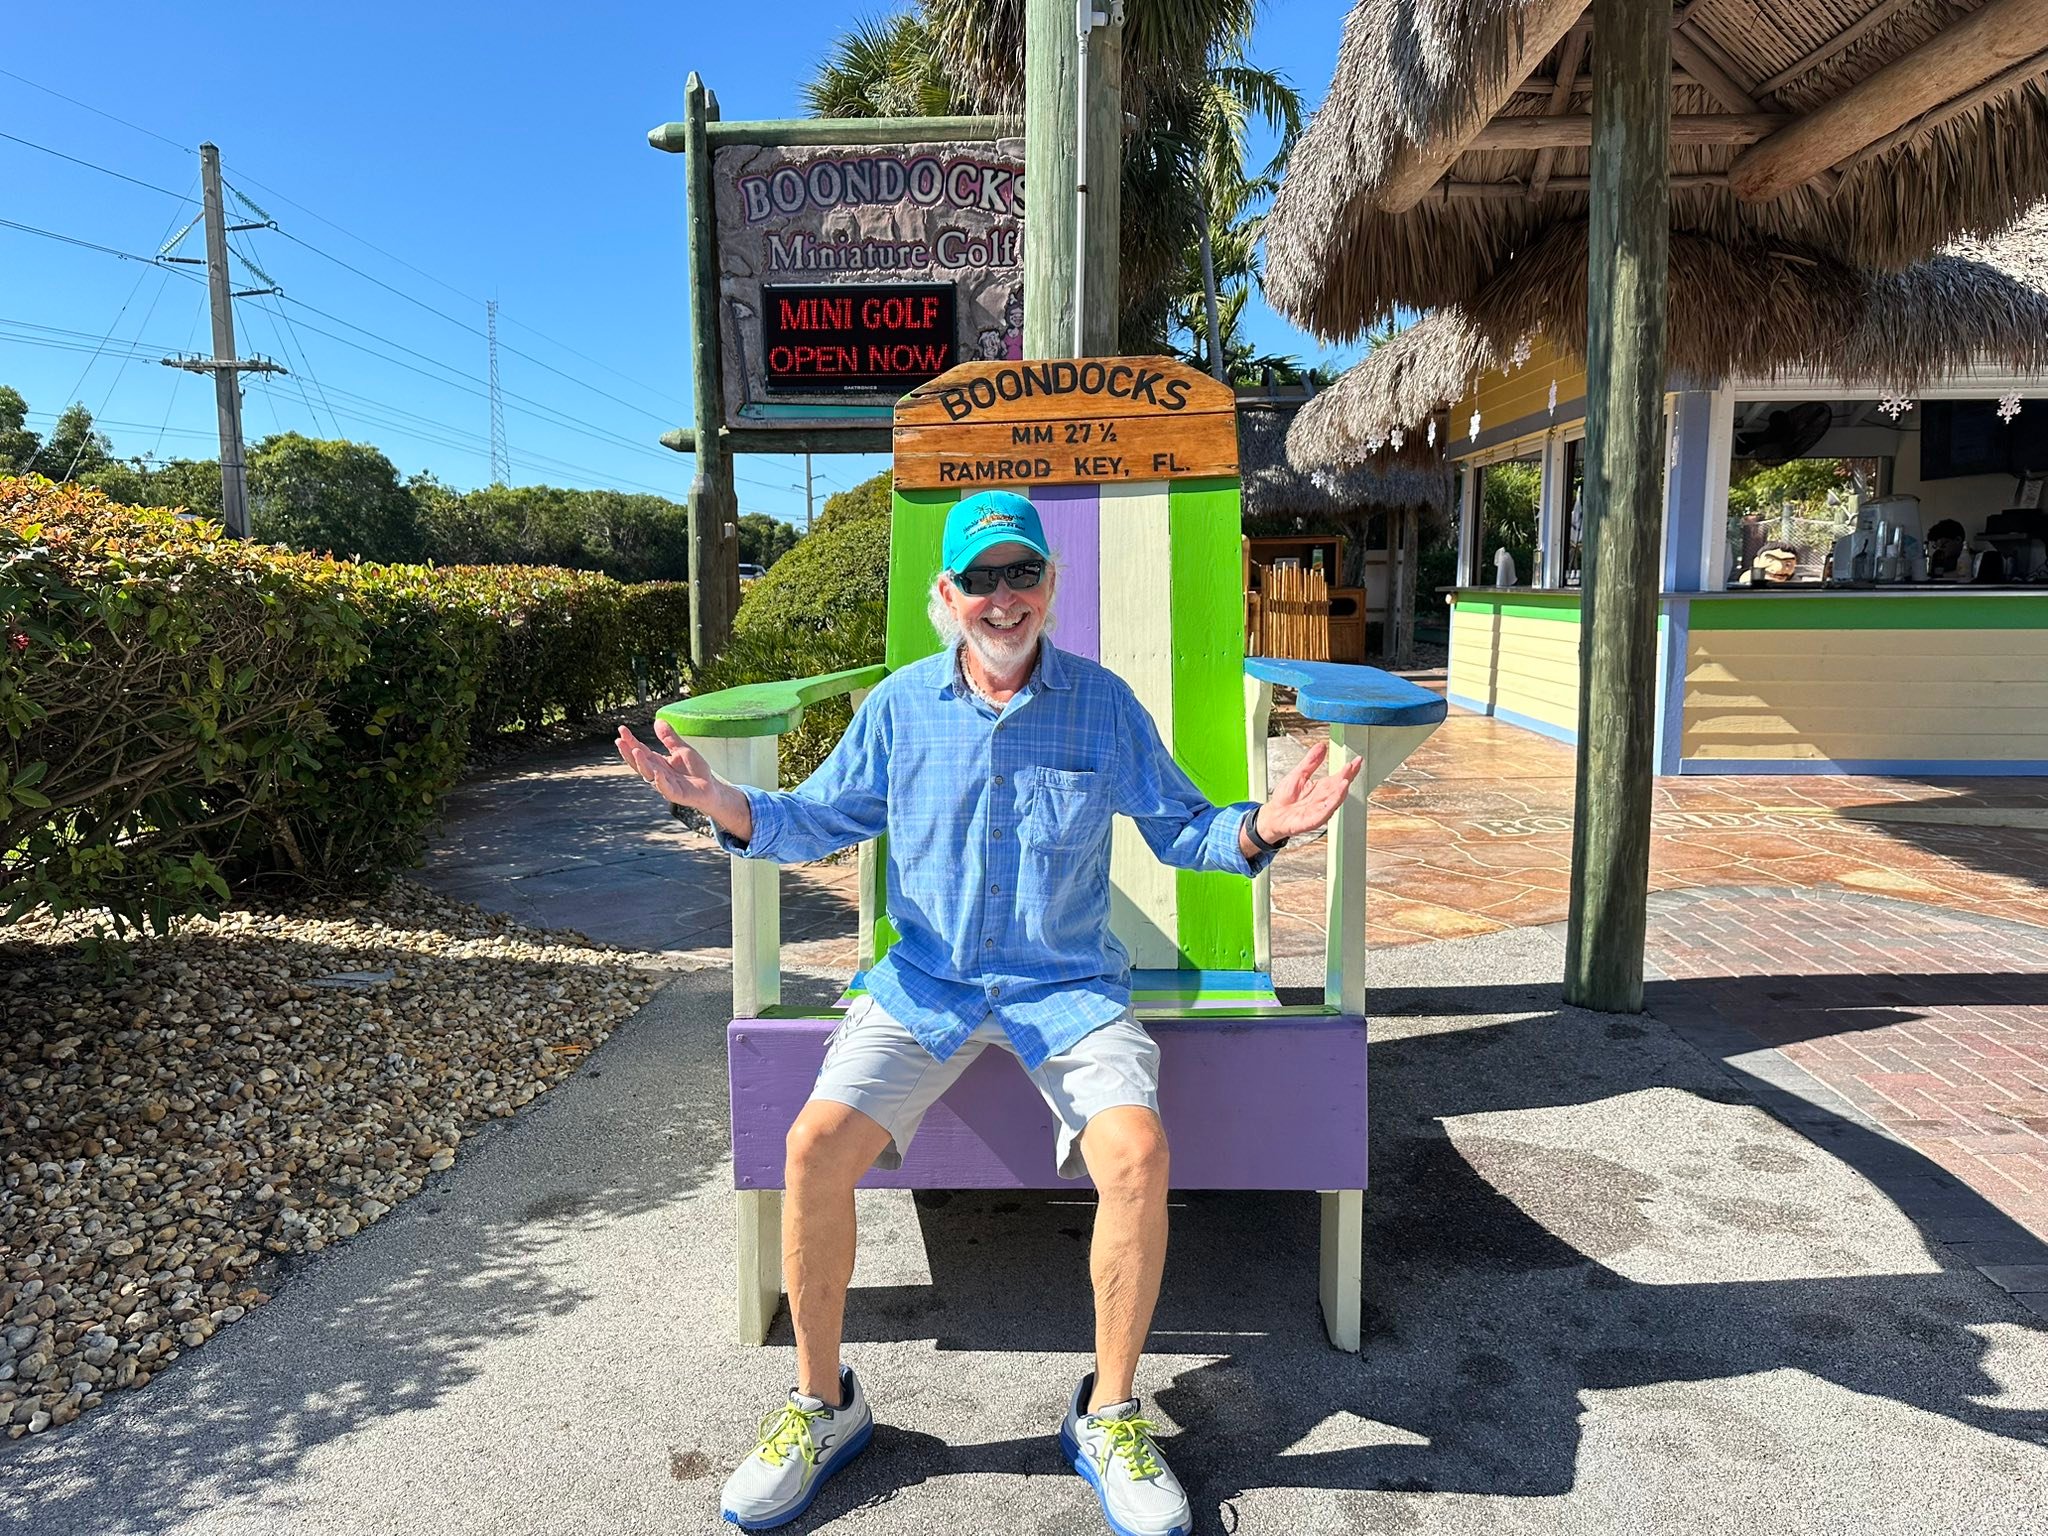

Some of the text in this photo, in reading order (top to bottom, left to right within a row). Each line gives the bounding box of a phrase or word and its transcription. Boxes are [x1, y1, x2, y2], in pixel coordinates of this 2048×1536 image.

[766, 229, 1016, 271] Miniature Golf
[779, 296, 940, 331] MINI GOLF
[768, 343, 949, 373] OPEN NOW
[939, 361, 1192, 421] BOONDOCKS
[1011, 424, 1053, 445] MM
[1064, 423, 1092, 444] 27
[939, 453, 1191, 482] RAMROD KEY, FL.
